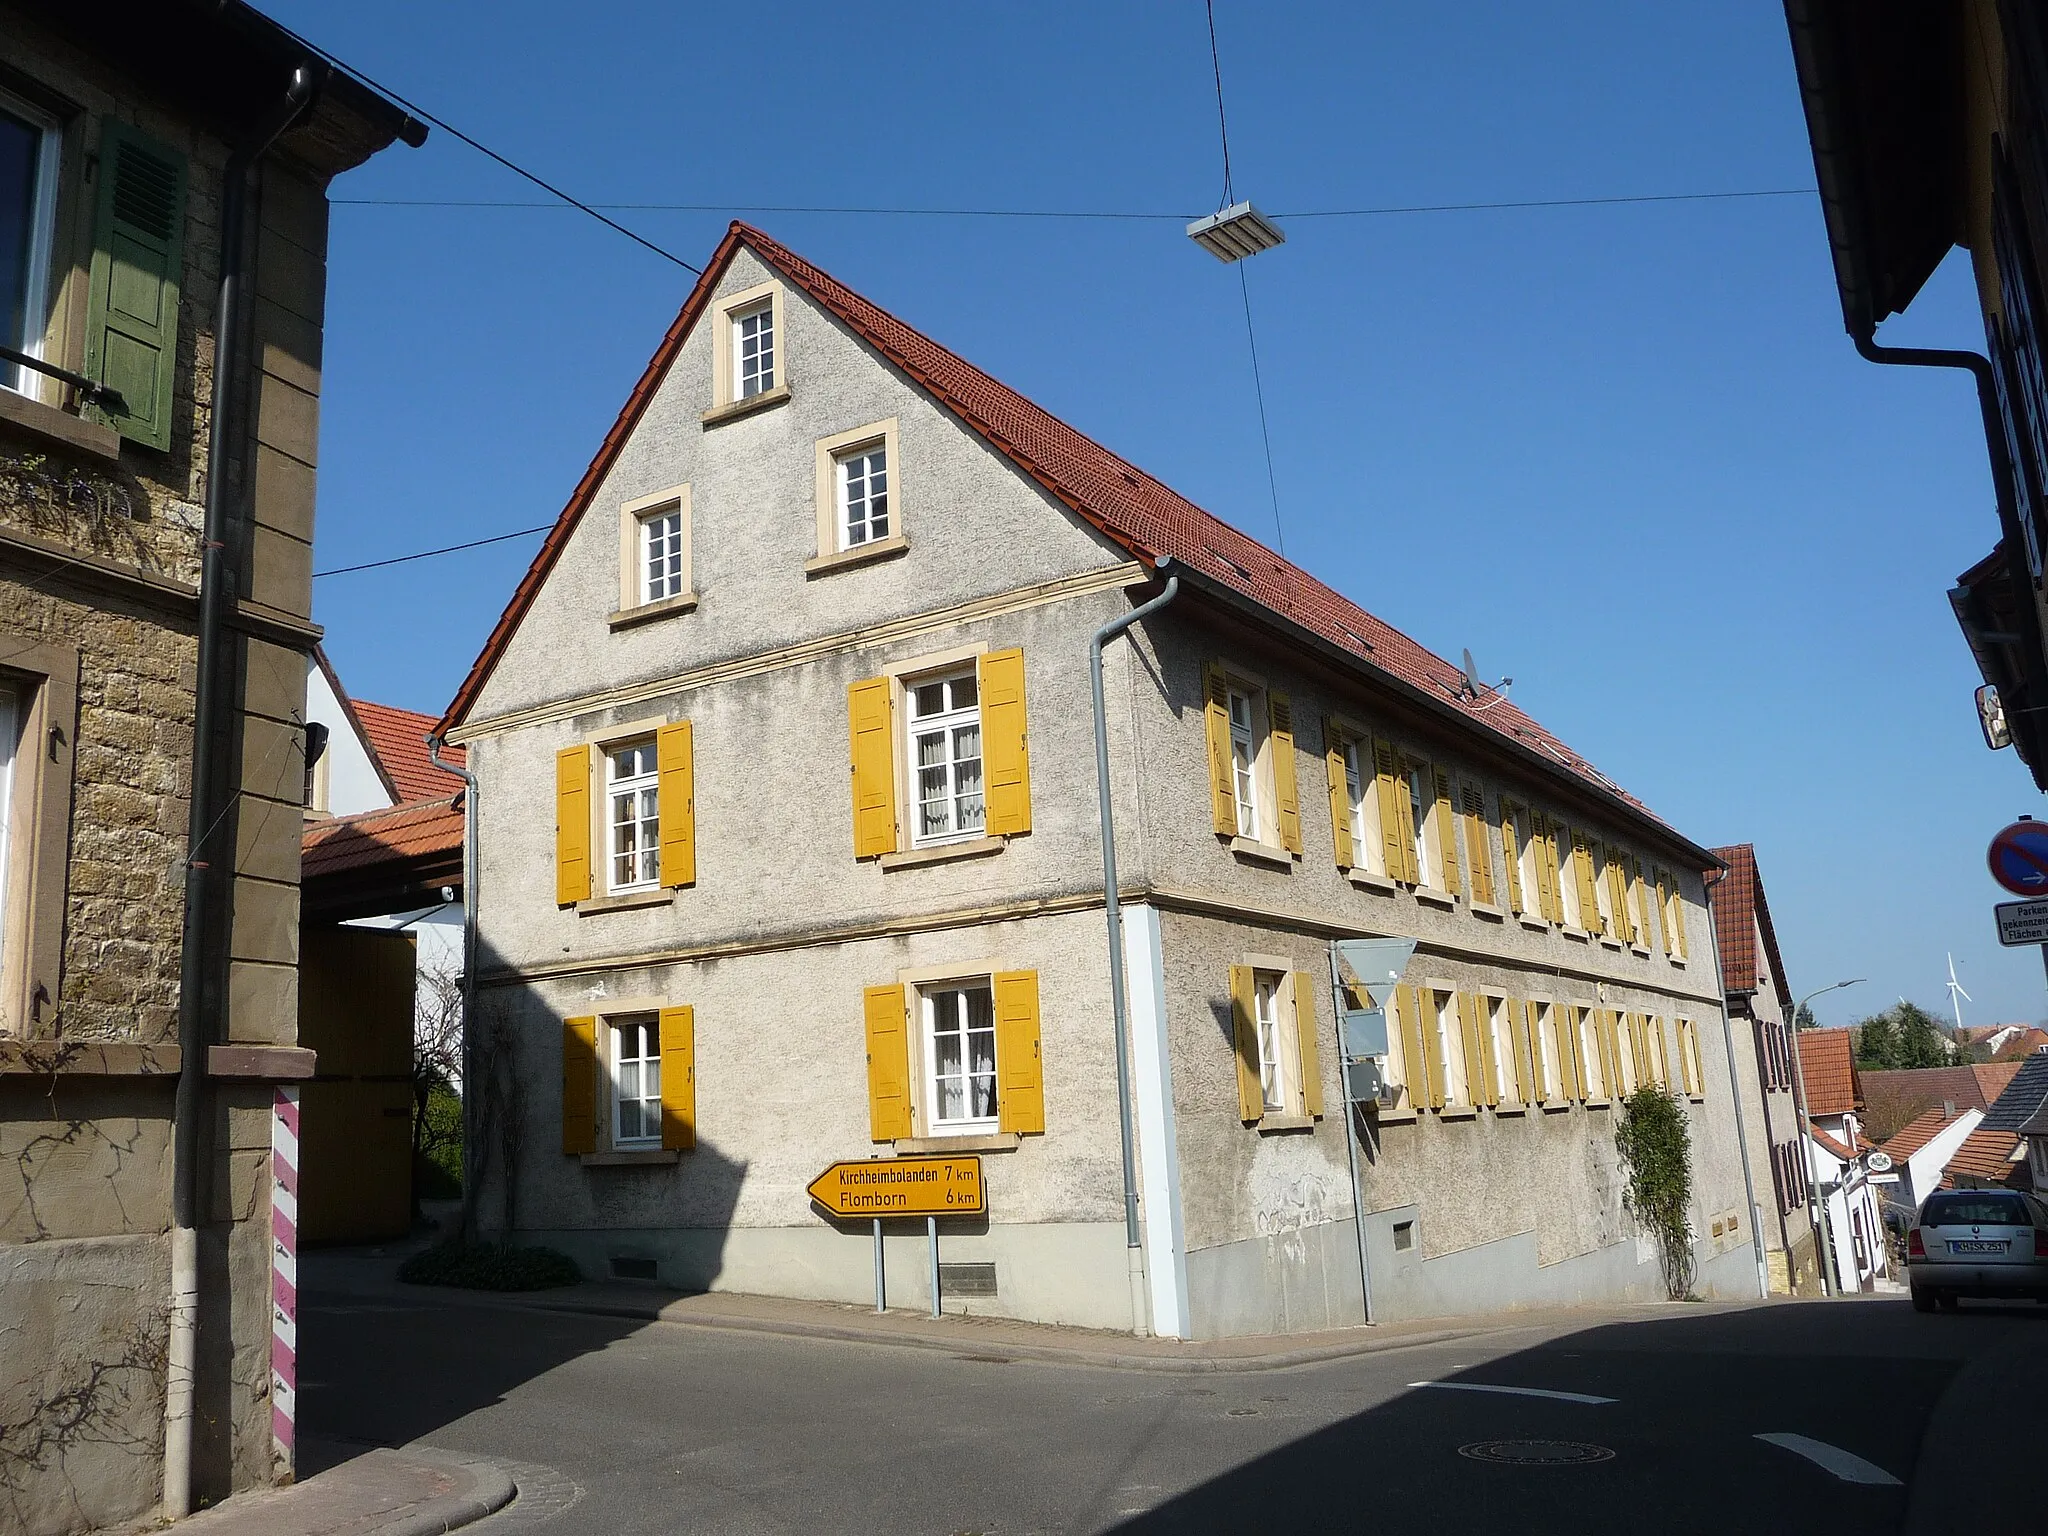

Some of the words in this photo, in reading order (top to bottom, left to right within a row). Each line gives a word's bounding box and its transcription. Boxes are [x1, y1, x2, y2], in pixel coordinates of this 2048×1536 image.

[2018, 906, 2048, 916] Parken
[2008, 929, 2042, 939] Flächen
[839, 1167, 938, 1186] Kirchheimbolanden
[944, 1165, 953, 1182] 7
[956, 1168, 974, 1181] km
[840, 1192, 907, 1207] Flomborn
[946, 1188, 954, 1204] 6
[957, 1191, 975, 1204] km
[1987, 1242, 2002, 1251] 251
